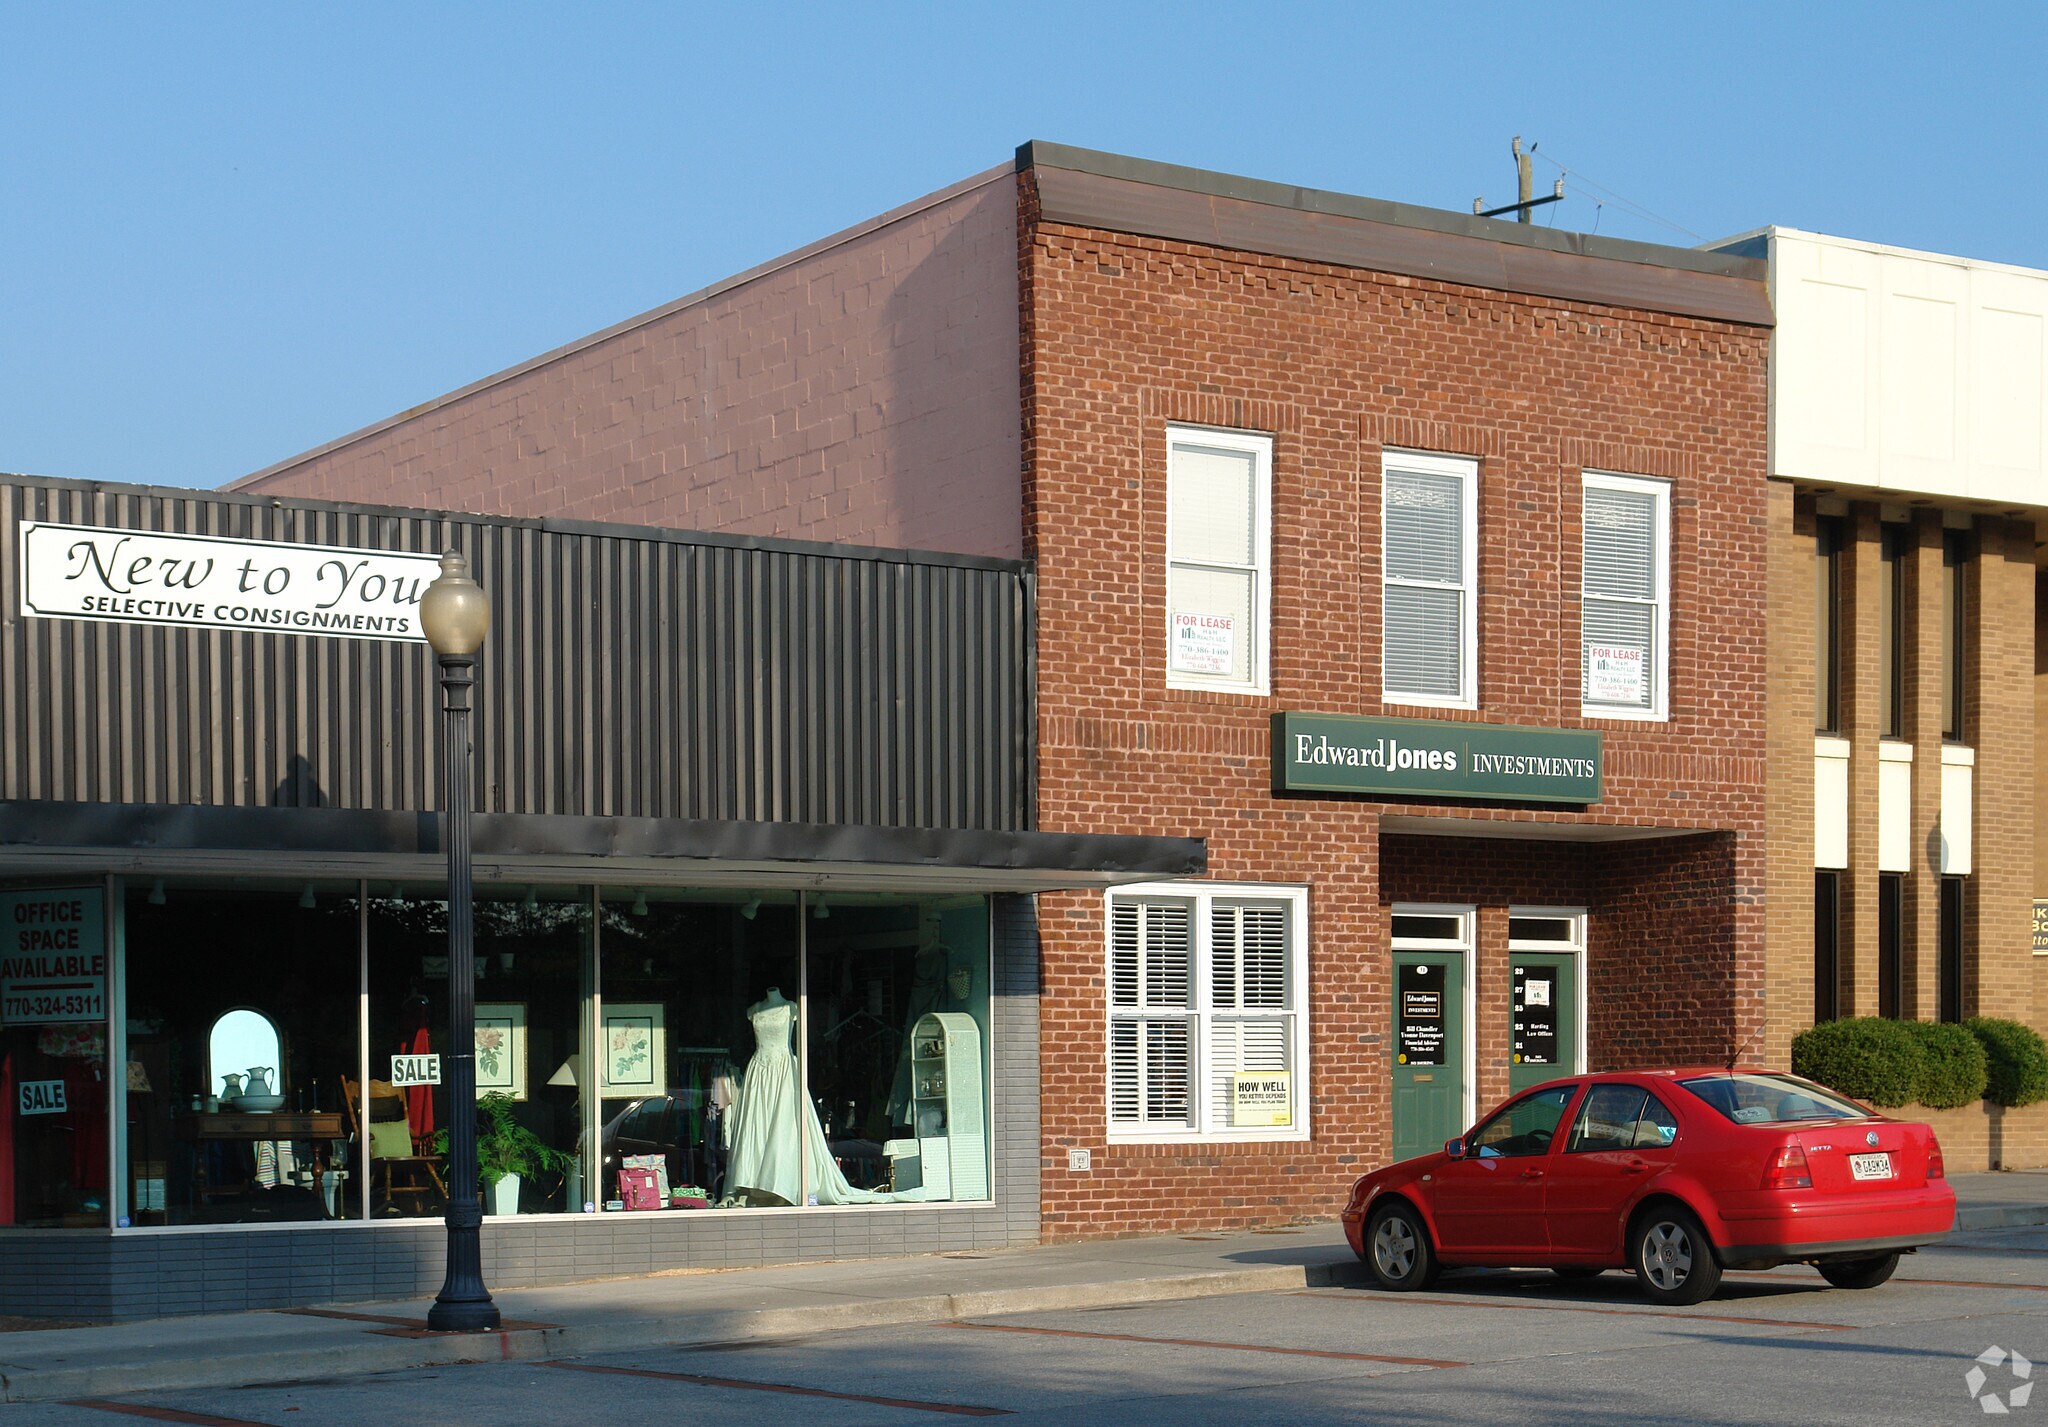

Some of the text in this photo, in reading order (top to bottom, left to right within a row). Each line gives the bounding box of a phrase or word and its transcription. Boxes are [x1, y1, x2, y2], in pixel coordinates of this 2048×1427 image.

[65, 537, 421, 609] New to You
[81, 595, 410, 633] SELECTIVE CONSIGNMENTS
[1176, 615, 1232, 630] FOR LEASE
[1592, 648, 1640, 661] FOR LEASE
[1472, 753, 1595, 779] INVESTMENTS
[14, 900, 82, 924] OFFICE
[19, 928, 79, 951] SPACE
[1, 955, 104, 979] AVAILABLE
[6, 995, 101, 1016] 770-324-5311
[394, 1058, 438, 1082] SALE
[22, 1084, 65, 1110] SALE
[1238, 1081, 1286, 1092] HOW WELL
